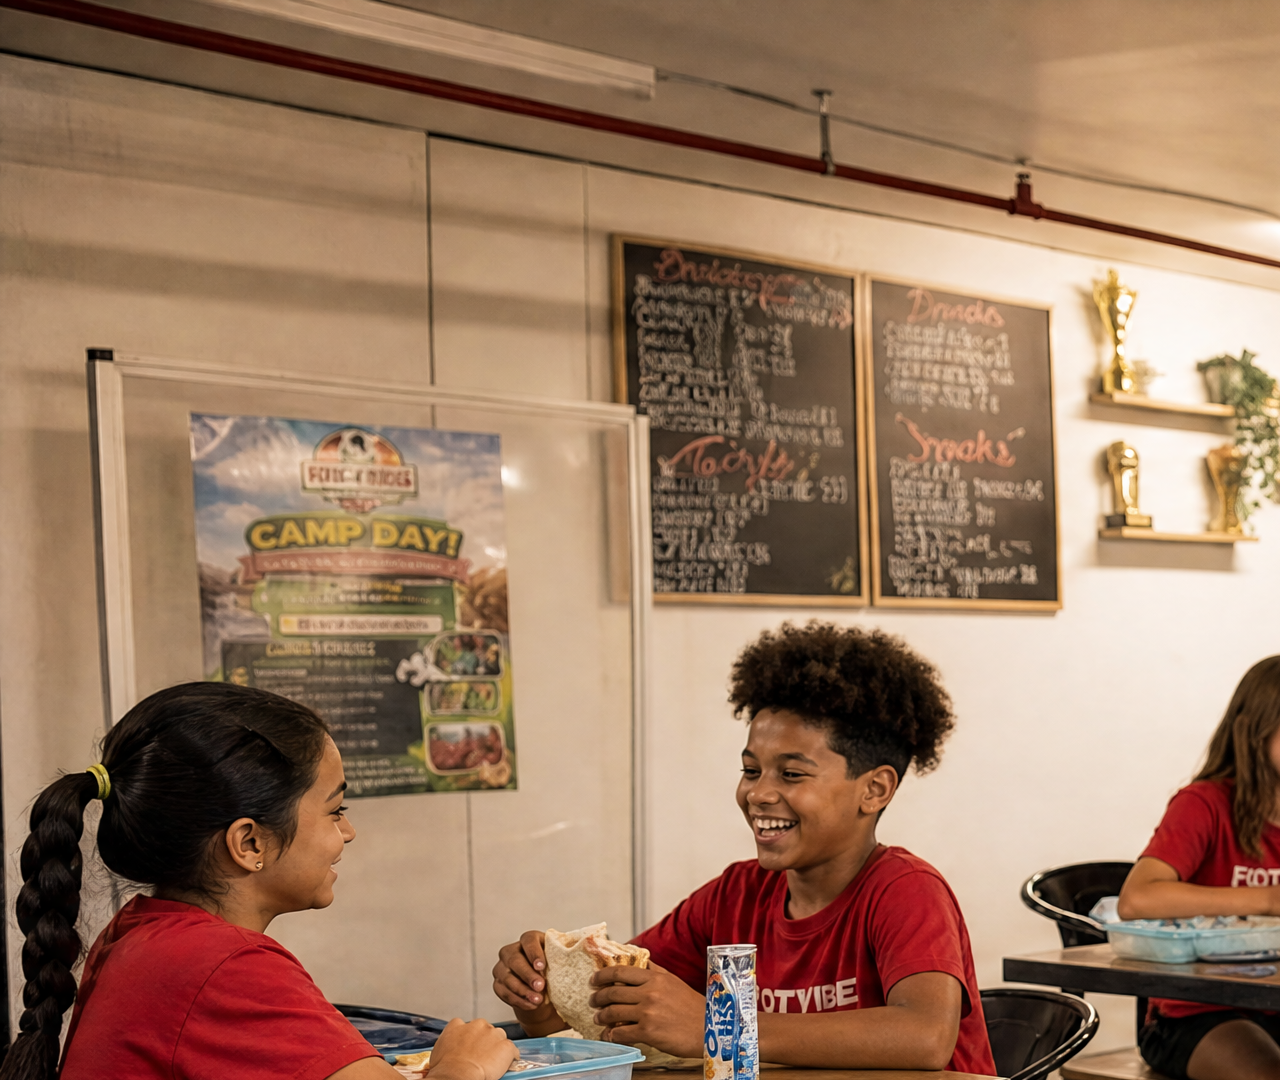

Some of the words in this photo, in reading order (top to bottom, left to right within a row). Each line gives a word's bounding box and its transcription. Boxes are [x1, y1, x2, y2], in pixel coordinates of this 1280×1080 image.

[250, 518, 363, 551] CAMP
[371, 520, 461, 557] DAY!
[756, 977, 859, 1014] OTVIBE
